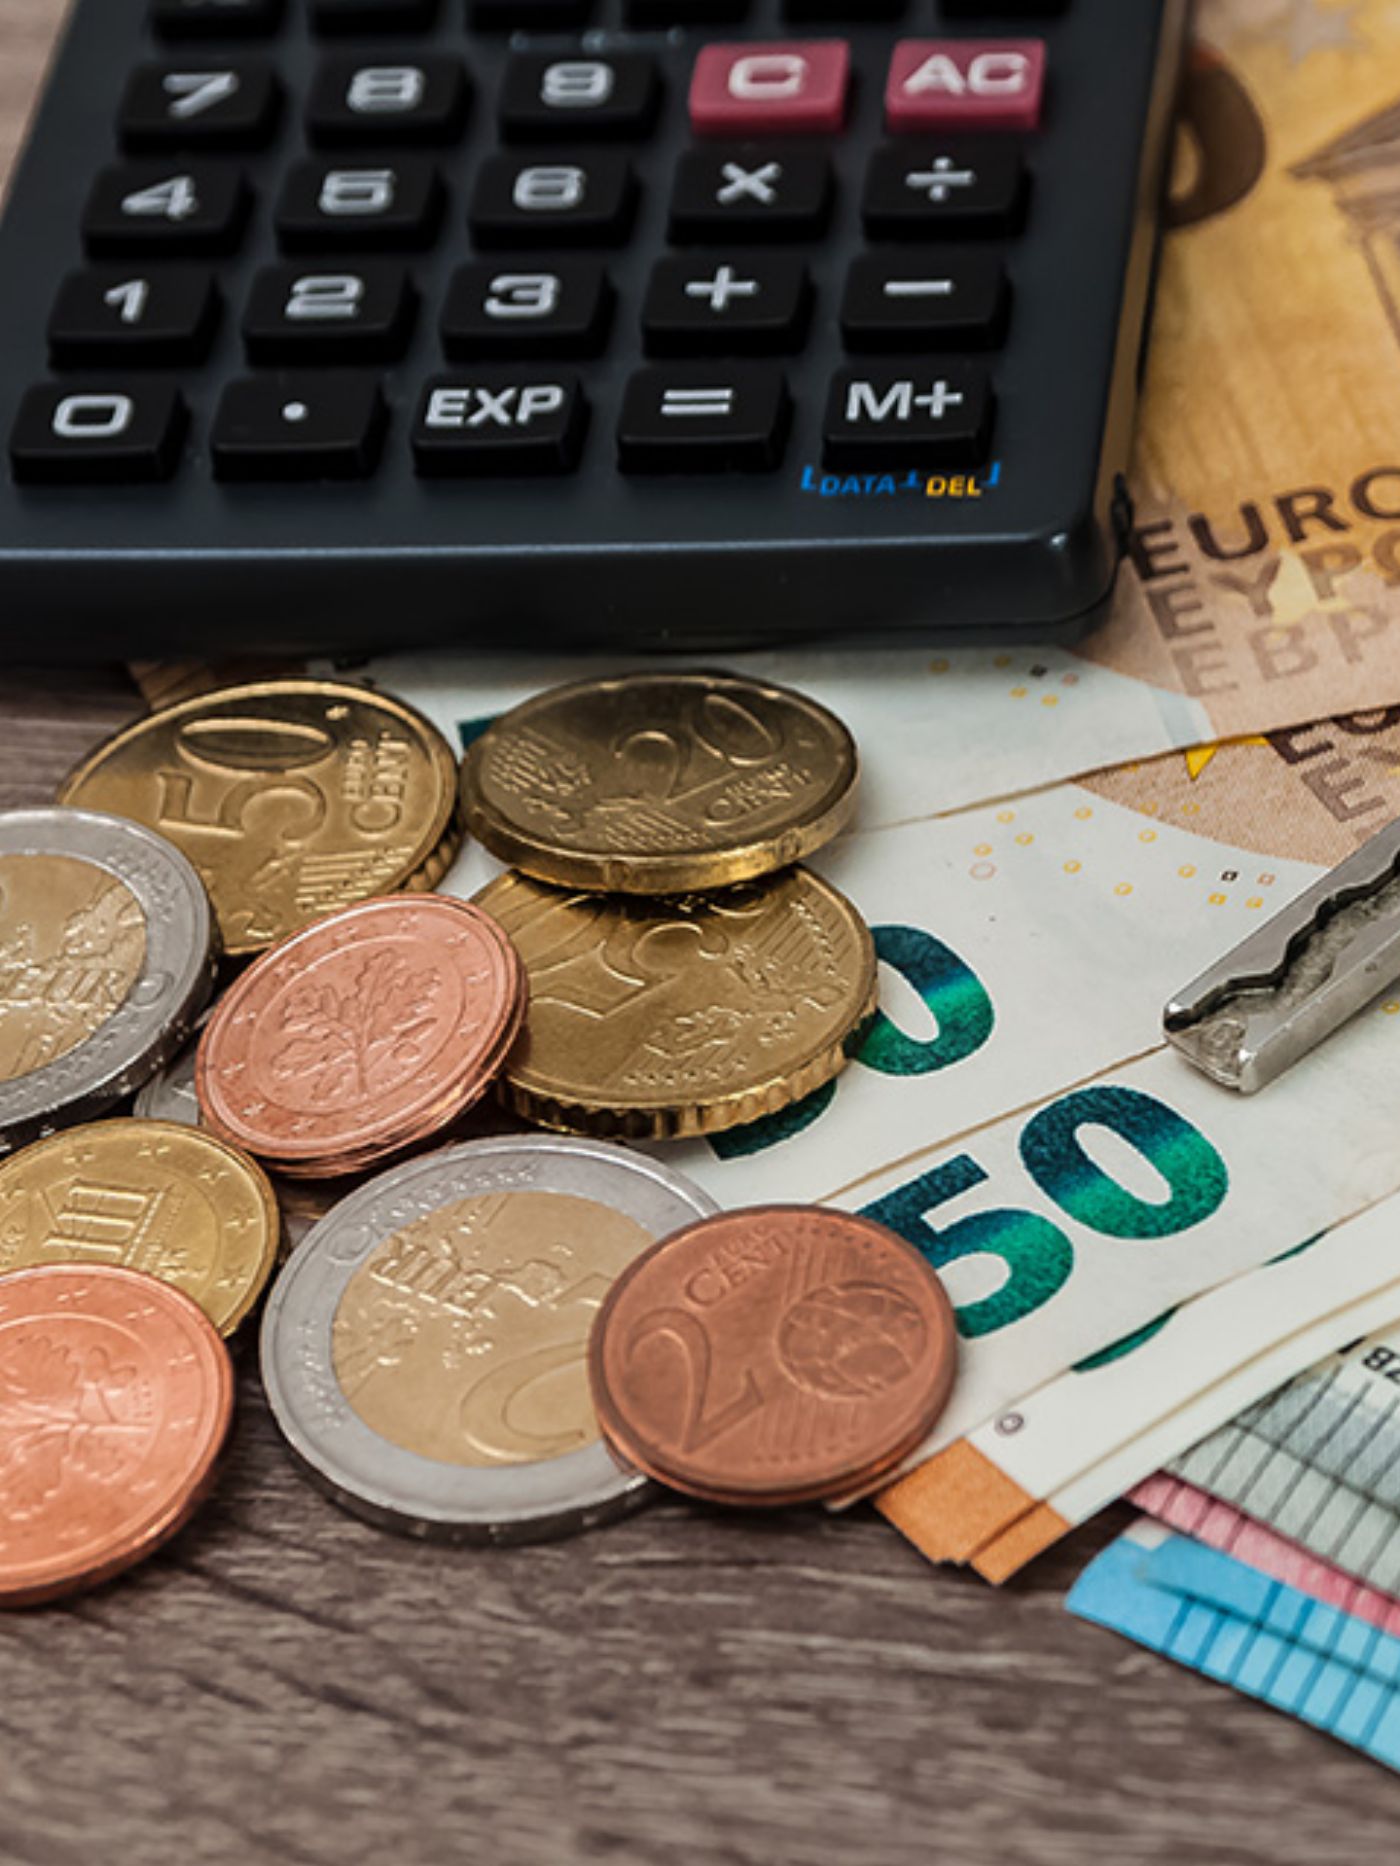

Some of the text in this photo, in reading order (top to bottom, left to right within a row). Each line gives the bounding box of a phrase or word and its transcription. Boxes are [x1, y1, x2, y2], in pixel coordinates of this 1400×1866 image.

[163, 72, 240, 118] 7
[347, 66, 424, 111] 8
[728, 54, 807, 100] C
[903, 52, 1028, 96] AC
[121, 175, 196, 219] 4
[319, 169, 394, 213] 5
[513, 166, 585, 210] 6
[104, 279, 148, 322] 1
[285, 275, 363, 318] 2
[484, 275, 559, 318] 3
[425, 385, 563, 426] EXP
[819, 474, 983, 497] DATA DEL
[856, 1085, 1230, 1340] 50
[624, 1306, 765, 1453] 2
